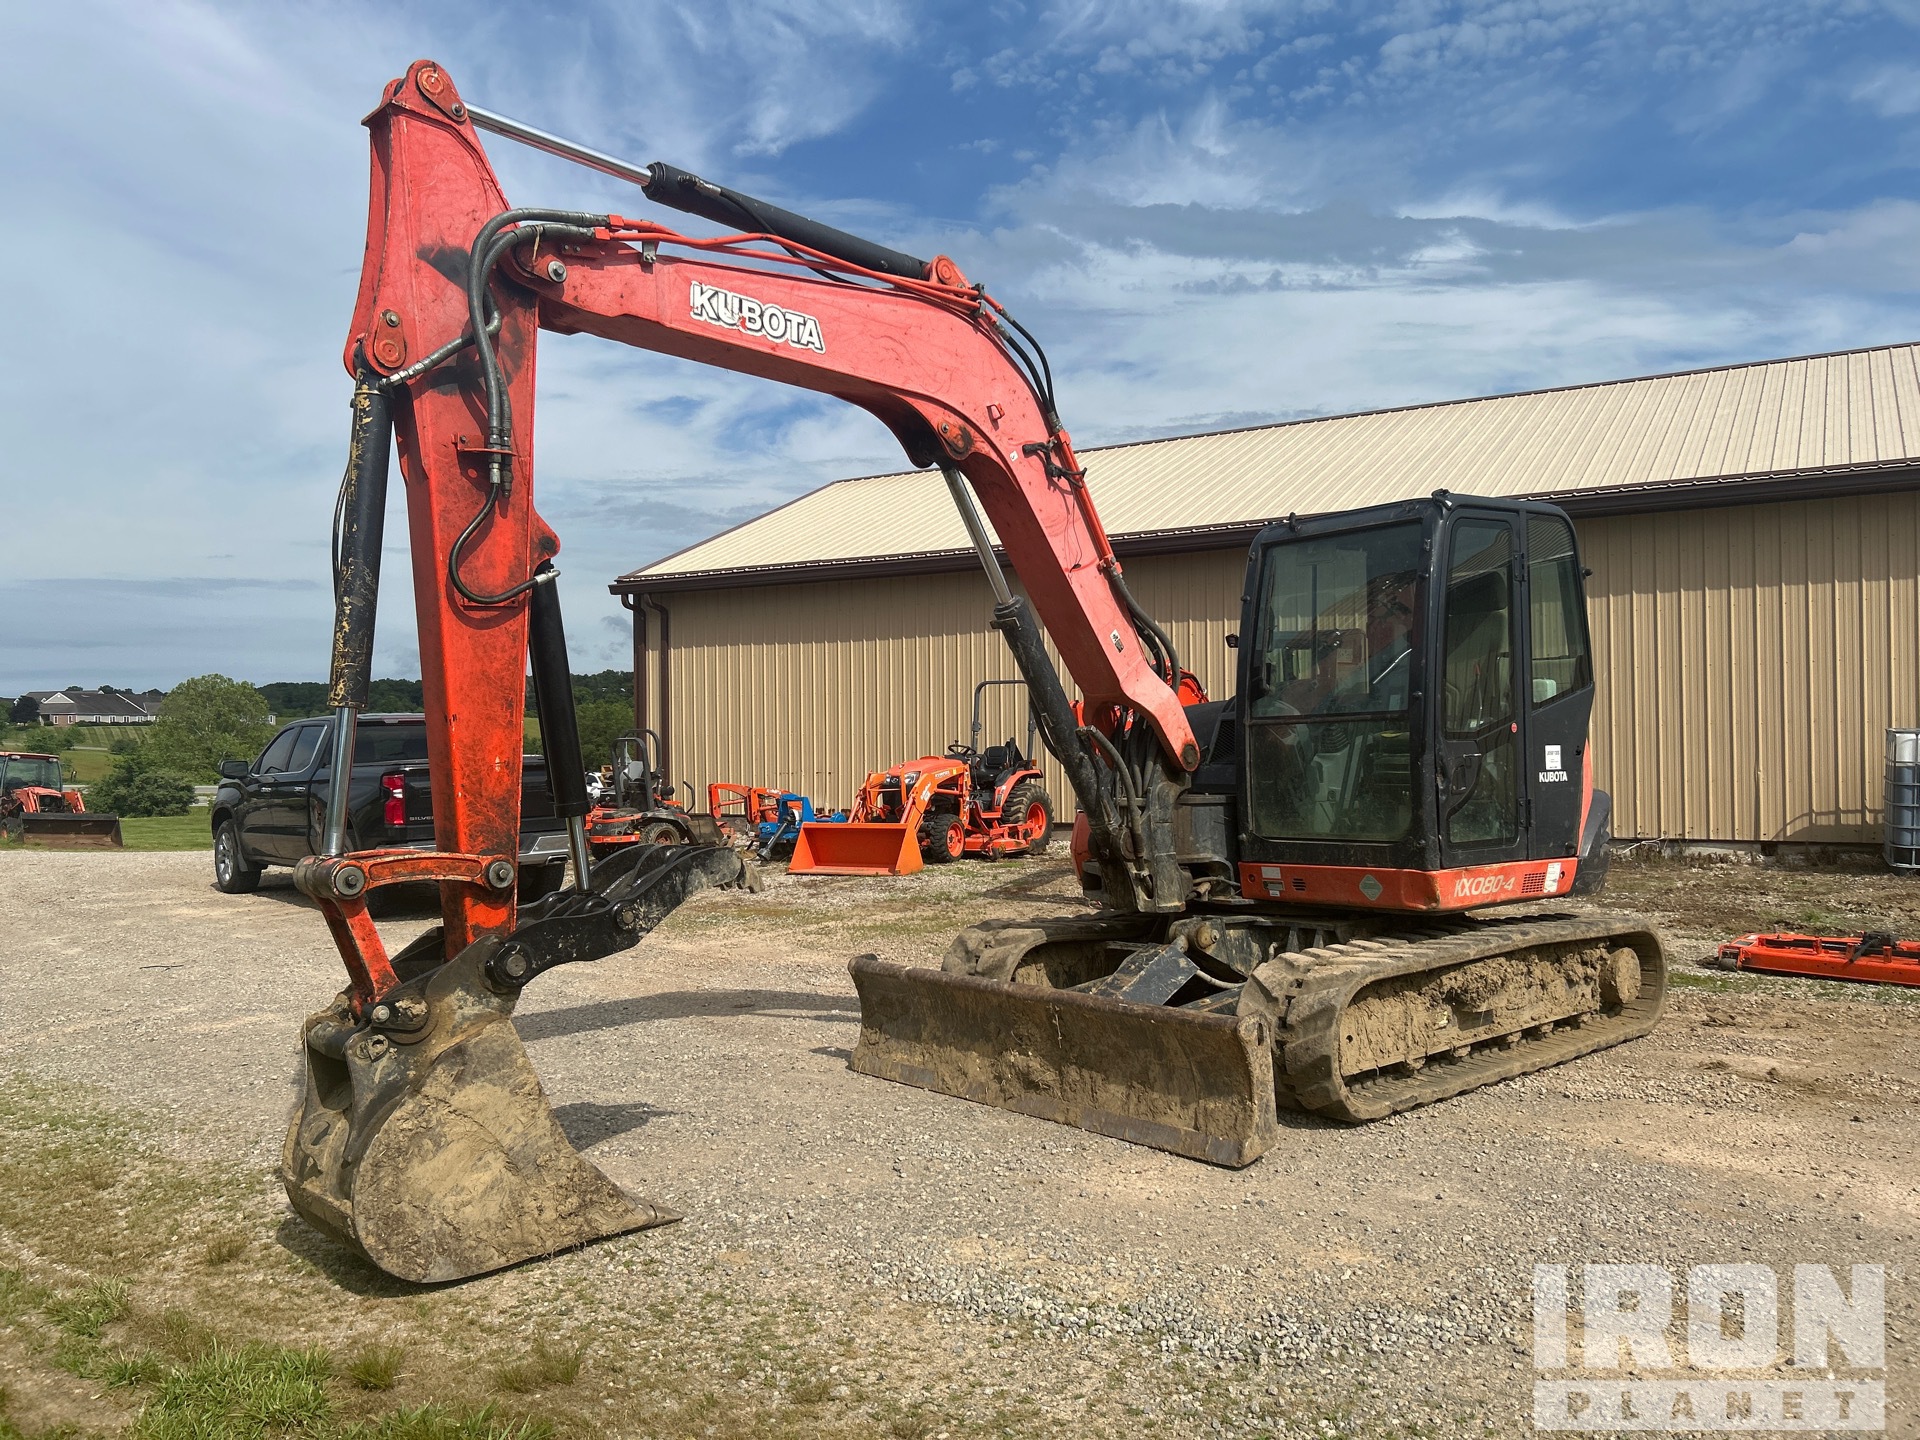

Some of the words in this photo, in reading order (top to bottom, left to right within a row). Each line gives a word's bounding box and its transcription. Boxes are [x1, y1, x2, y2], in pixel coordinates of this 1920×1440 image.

[691, 282, 824, 352] KUBOTA
[1539, 771, 1568, 782] KUBOTA
[1454, 875, 1516, 897] KX080-4
